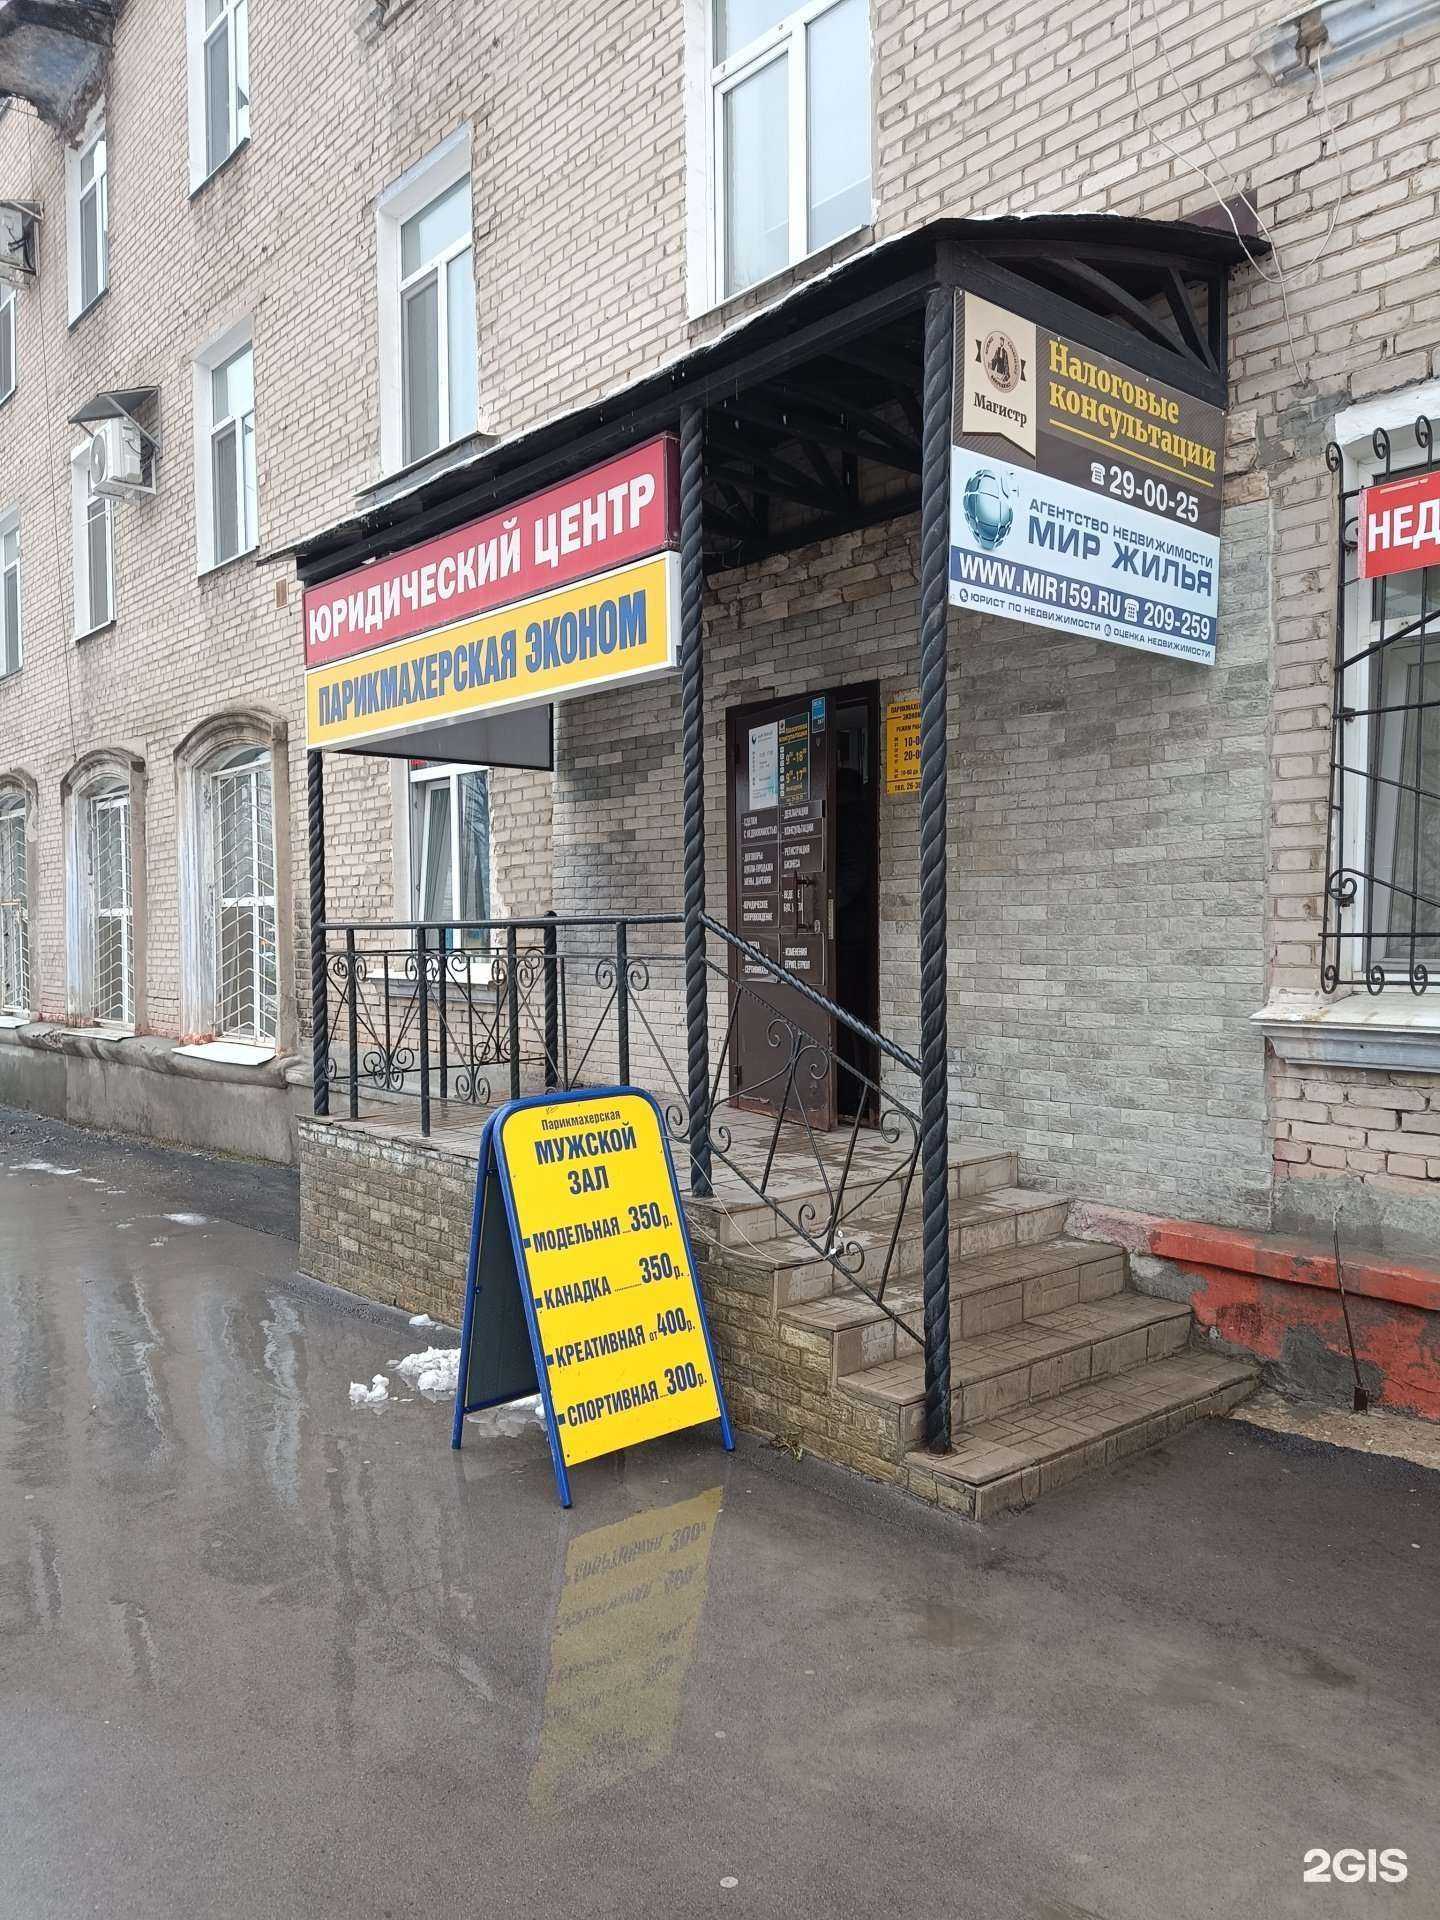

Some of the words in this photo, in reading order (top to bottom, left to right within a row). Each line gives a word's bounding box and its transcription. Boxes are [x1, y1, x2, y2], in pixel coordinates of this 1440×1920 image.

[973, 391, 1028, 428] Магистр
[1049, 339, 1180, 424] Налоговые
[1049, 381, 1217, 472] консультации
[1109, 466, 1200, 523] 29-00-25
[309, 517, 521, 645] ЮРИДИЧЕСКИЙ
[534, 473, 656, 569] ЦЕНТР
[1028, 517, 1101, 560] МИР
[1111, 541, 1213, 597] ЖИЛЬЯ
[1029, 498, 1109, 533] АГЕНТСТВО
[1113, 525, 1214, 569] НЕДВИЖИМОСТИ
[959, 552, 1121, 617] WWW.MIR159.RU
[1144, 604, 1211, 641] 209-259
[970, 592, 1006, 609] ЮРИСТ
[1008, 602, 1022, 613] ПО
[1024, 605, 1101, 632] НЕДВИЖИМОСТИ
[1114, 628, 1145, 643] ОЦЕНКА
[1148, 636, 1211, 658] НЕДВИЖИМОСТИ
[318, 628, 518, 727] ПАРИКМАХЕРСКАЯ
[525, 589, 647, 674] ЭКОНОМ
[534, 1121, 637, 1165] МУЖСКОЙ
[541, 1110, 621, 1131] Парикмахерская
[567, 1165, 610, 1195] ЗАЛ
[533, 1217, 621, 1253] МОДЕЛЬНАЯ
[543, 1276, 612, 1310] КАНАДКА
[555, 1325, 646, 1368] КРЕАТИВНАЯ
[567, 1381, 659, 1427] СПОРТИВНАЯ
